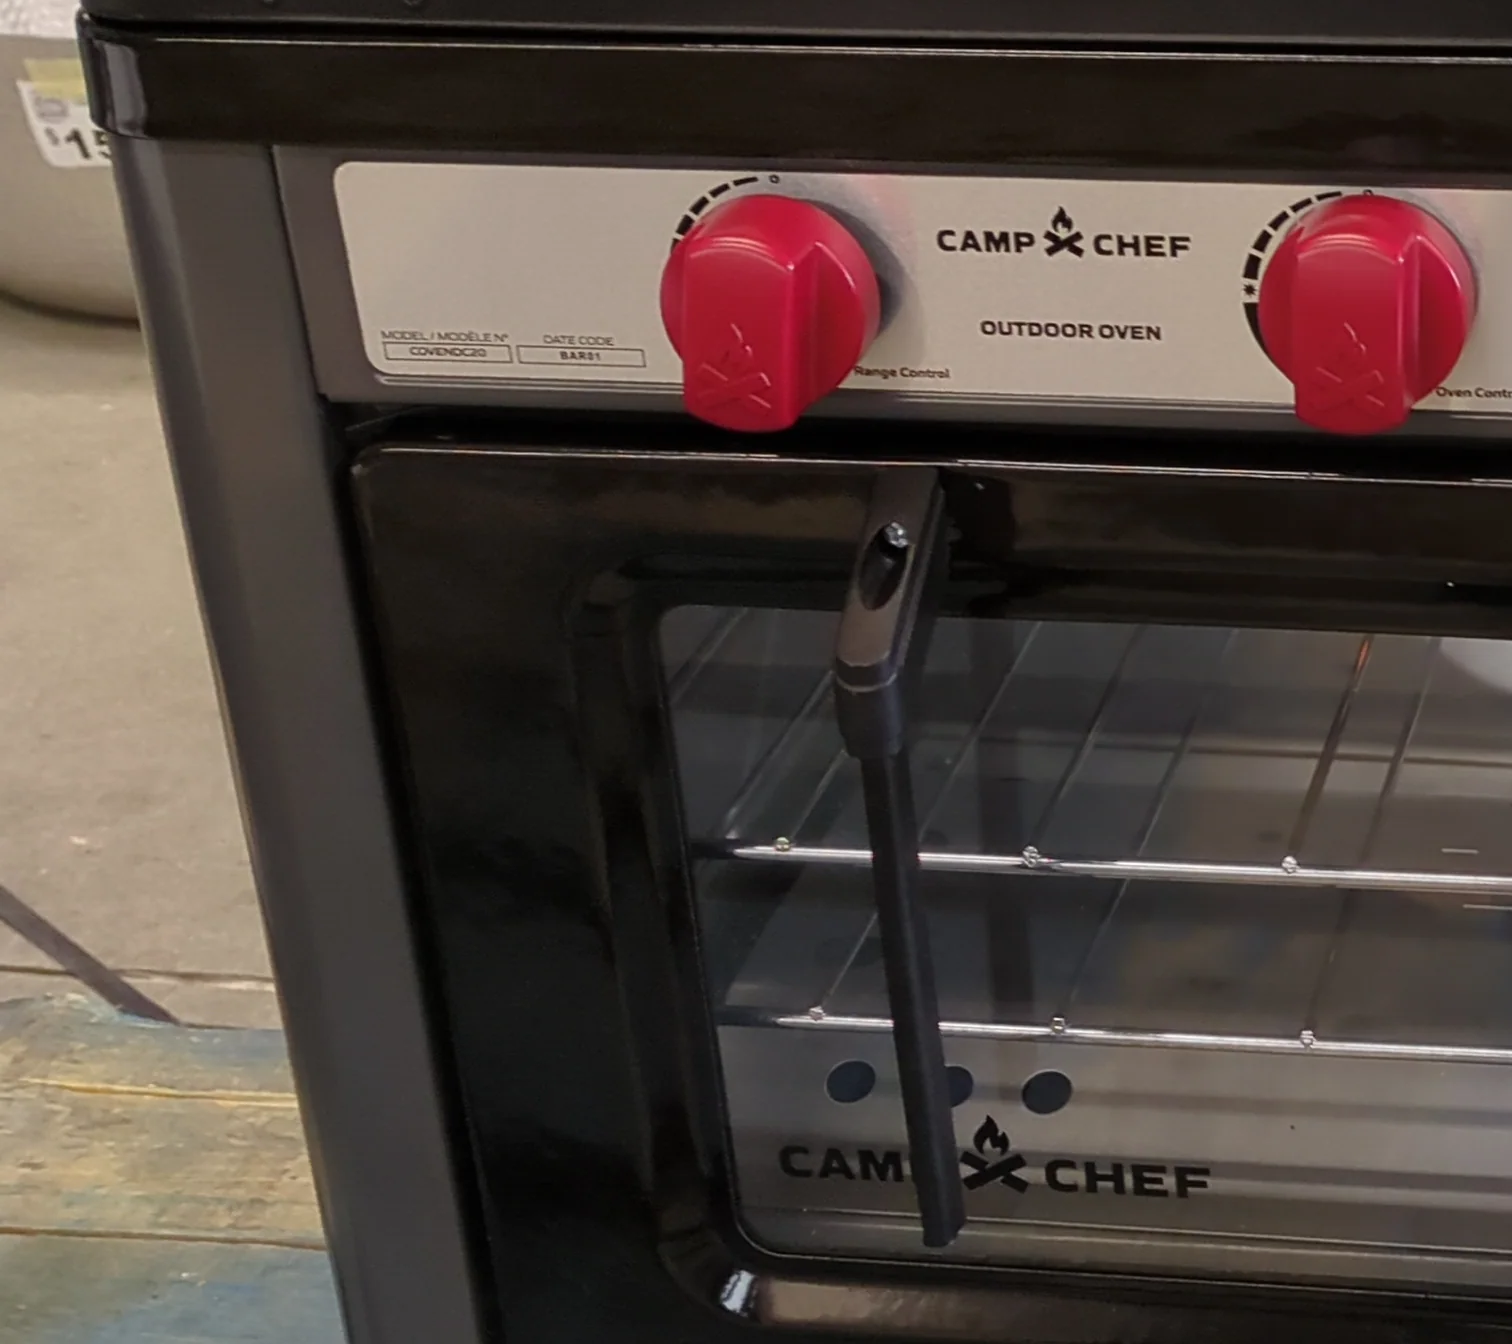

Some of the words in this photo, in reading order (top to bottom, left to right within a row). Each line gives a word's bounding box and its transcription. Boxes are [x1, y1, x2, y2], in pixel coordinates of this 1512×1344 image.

[936, 229, 1036, 255] CAMP
[1092, 233, 1191, 258] CHEF
[381, 330, 427, 341] MODEL
[980, 320, 1094, 340] OUTDOOR
[1098, 323, 1162, 341] OVEN
[543, 335, 576, 345] DATE
[578, 336, 615, 346] CODE
[854, 365, 898, 380] Range
[899, 367, 951, 378] Control
[1435, 386, 1473, 397] Oven
[778, 1145, 905, 1182] CAM
[1044, 1159, 1211, 1199] CHEF
